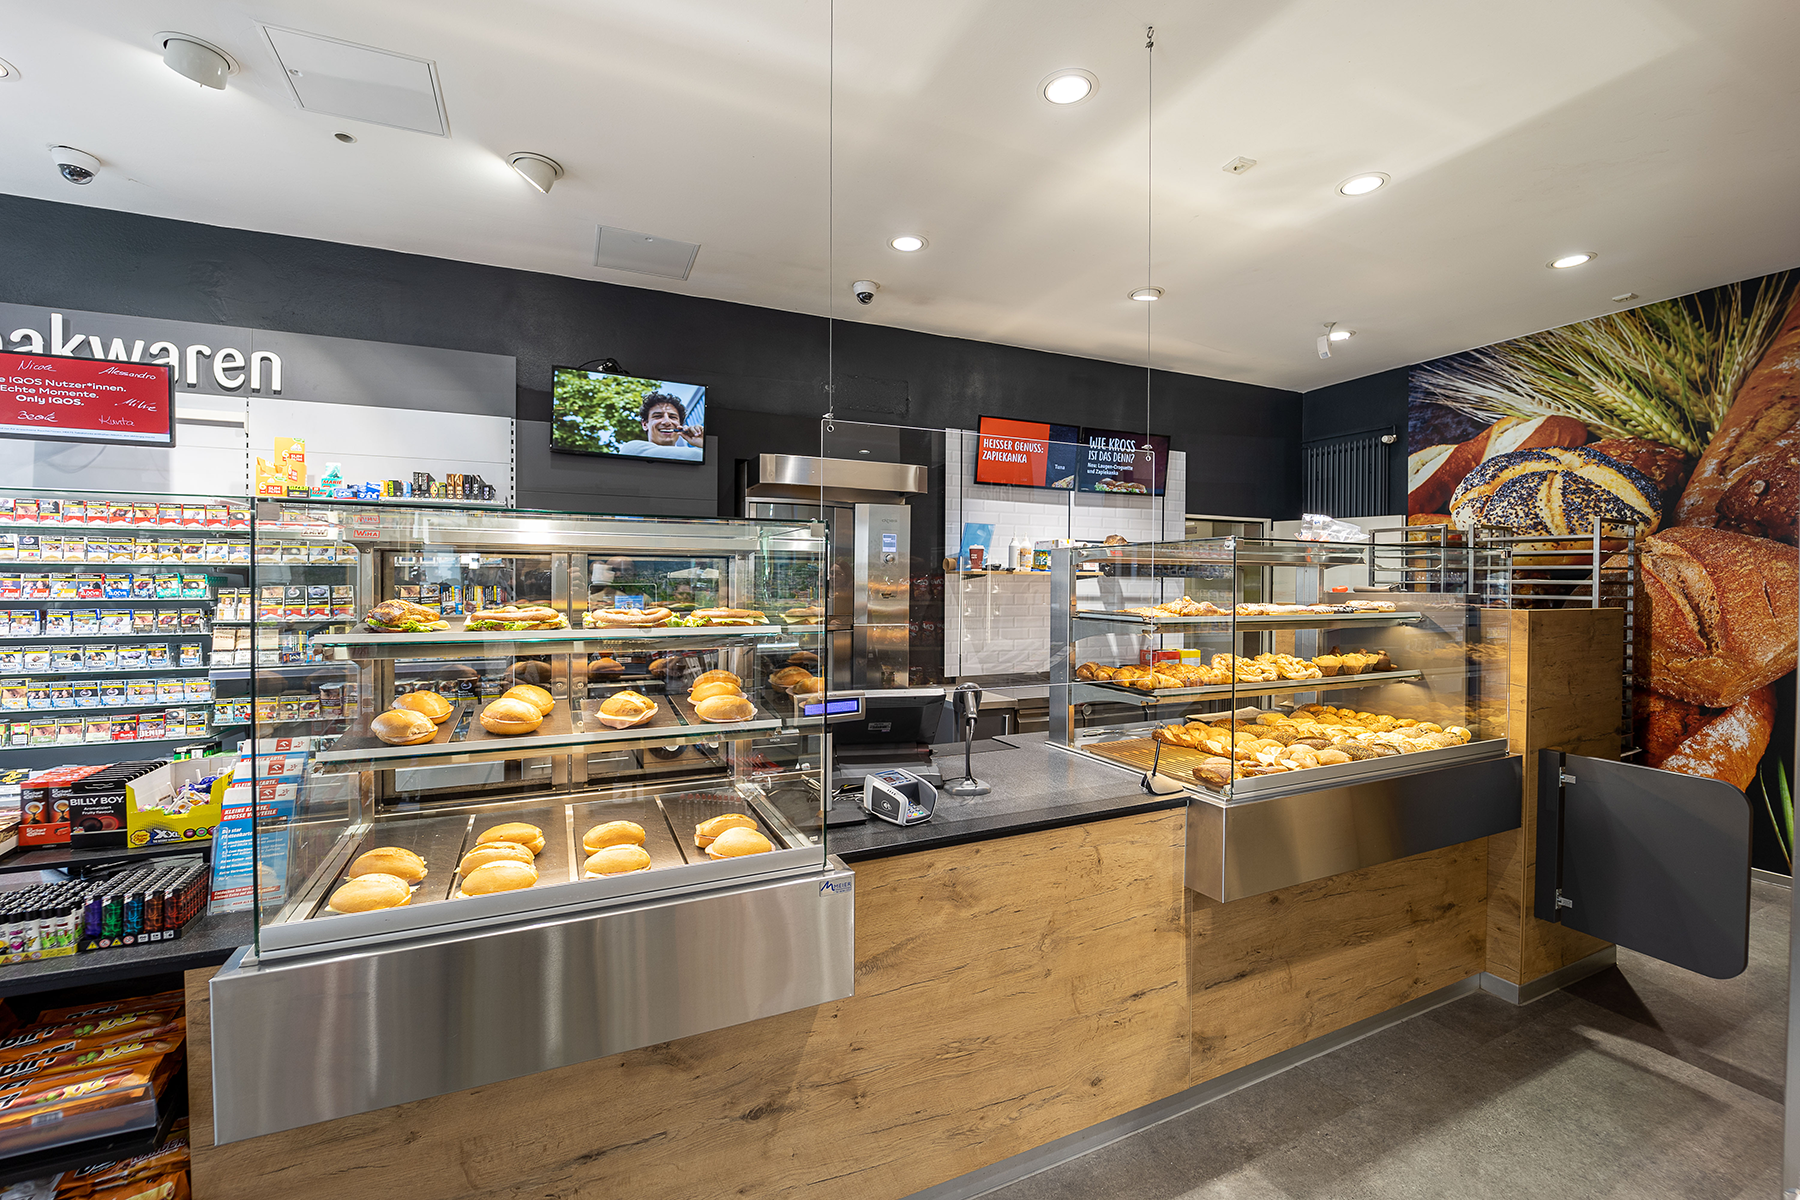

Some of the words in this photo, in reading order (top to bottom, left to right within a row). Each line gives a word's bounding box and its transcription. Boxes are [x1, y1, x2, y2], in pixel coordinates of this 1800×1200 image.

[0, 313, 281, 392] akwaren
[99, 366, 157, 380] Alessandro
[9, 376, 43, 386] IQOS
[0, 385, 36, 394] Echte
[39, 388, 99, 399] Momente.
[15, 395, 46, 405] Only
[48, 397, 85, 406] IQOS.
[983, 438, 1012, 450] HEISSER
[1015, 442, 1044, 454] GENUSS:
[1089, 436, 1106, 450] WIE
[1109, 438, 1136, 453] KROSS
[982, 450, 1027, 463] ZAPIEKANKA
[1088, 450, 1098, 461] IST
[1099, 451, 1112, 462] DAS
[1113, 452, 1135, 464] DENN?
[70, 797, 99, 806] BILLY
[100, 796, 124, 804] BOY
[223, 812, 246, 820] GROSSE
[224, 807, 246, 815] KLEINE
[153, 829, 182, 839] XXL
